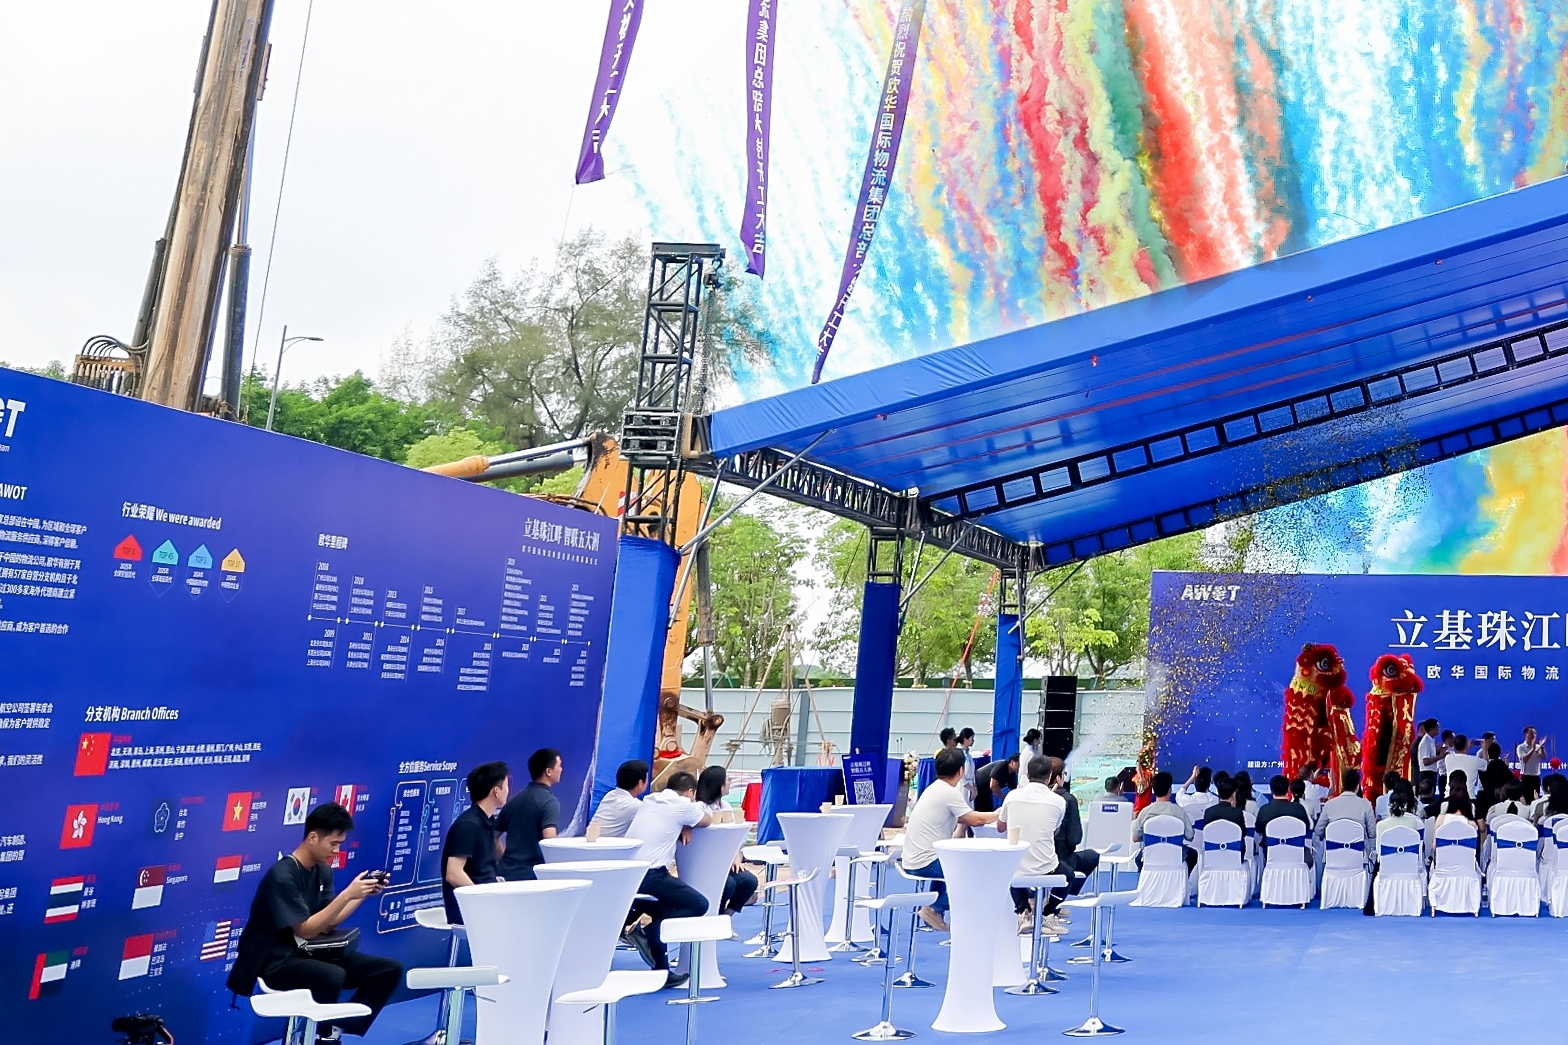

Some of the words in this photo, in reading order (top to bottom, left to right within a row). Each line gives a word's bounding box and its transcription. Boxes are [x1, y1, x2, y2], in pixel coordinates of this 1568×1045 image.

[121, 501, 155, 521] 行业荣耀
[155, 508, 168, 522] We
[168, 514, 188, 525] were
[188, 516, 222, 530] awarded
[564, 526, 600, 552] 智联五大洲
[1181, 584, 1240, 601] AWOT
[85, 706, 120, 722] 分支机构
[121, 707, 150, 721] Branch
[151, 706, 179, 720] Offices
[424, 761, 442, 772] Service
[442, 760, 458, 771] Scope
[97, 816, 110, 825] Hong
[110, 815, 123, 824] Kong
[166, 875, 188, 885] Singapore
